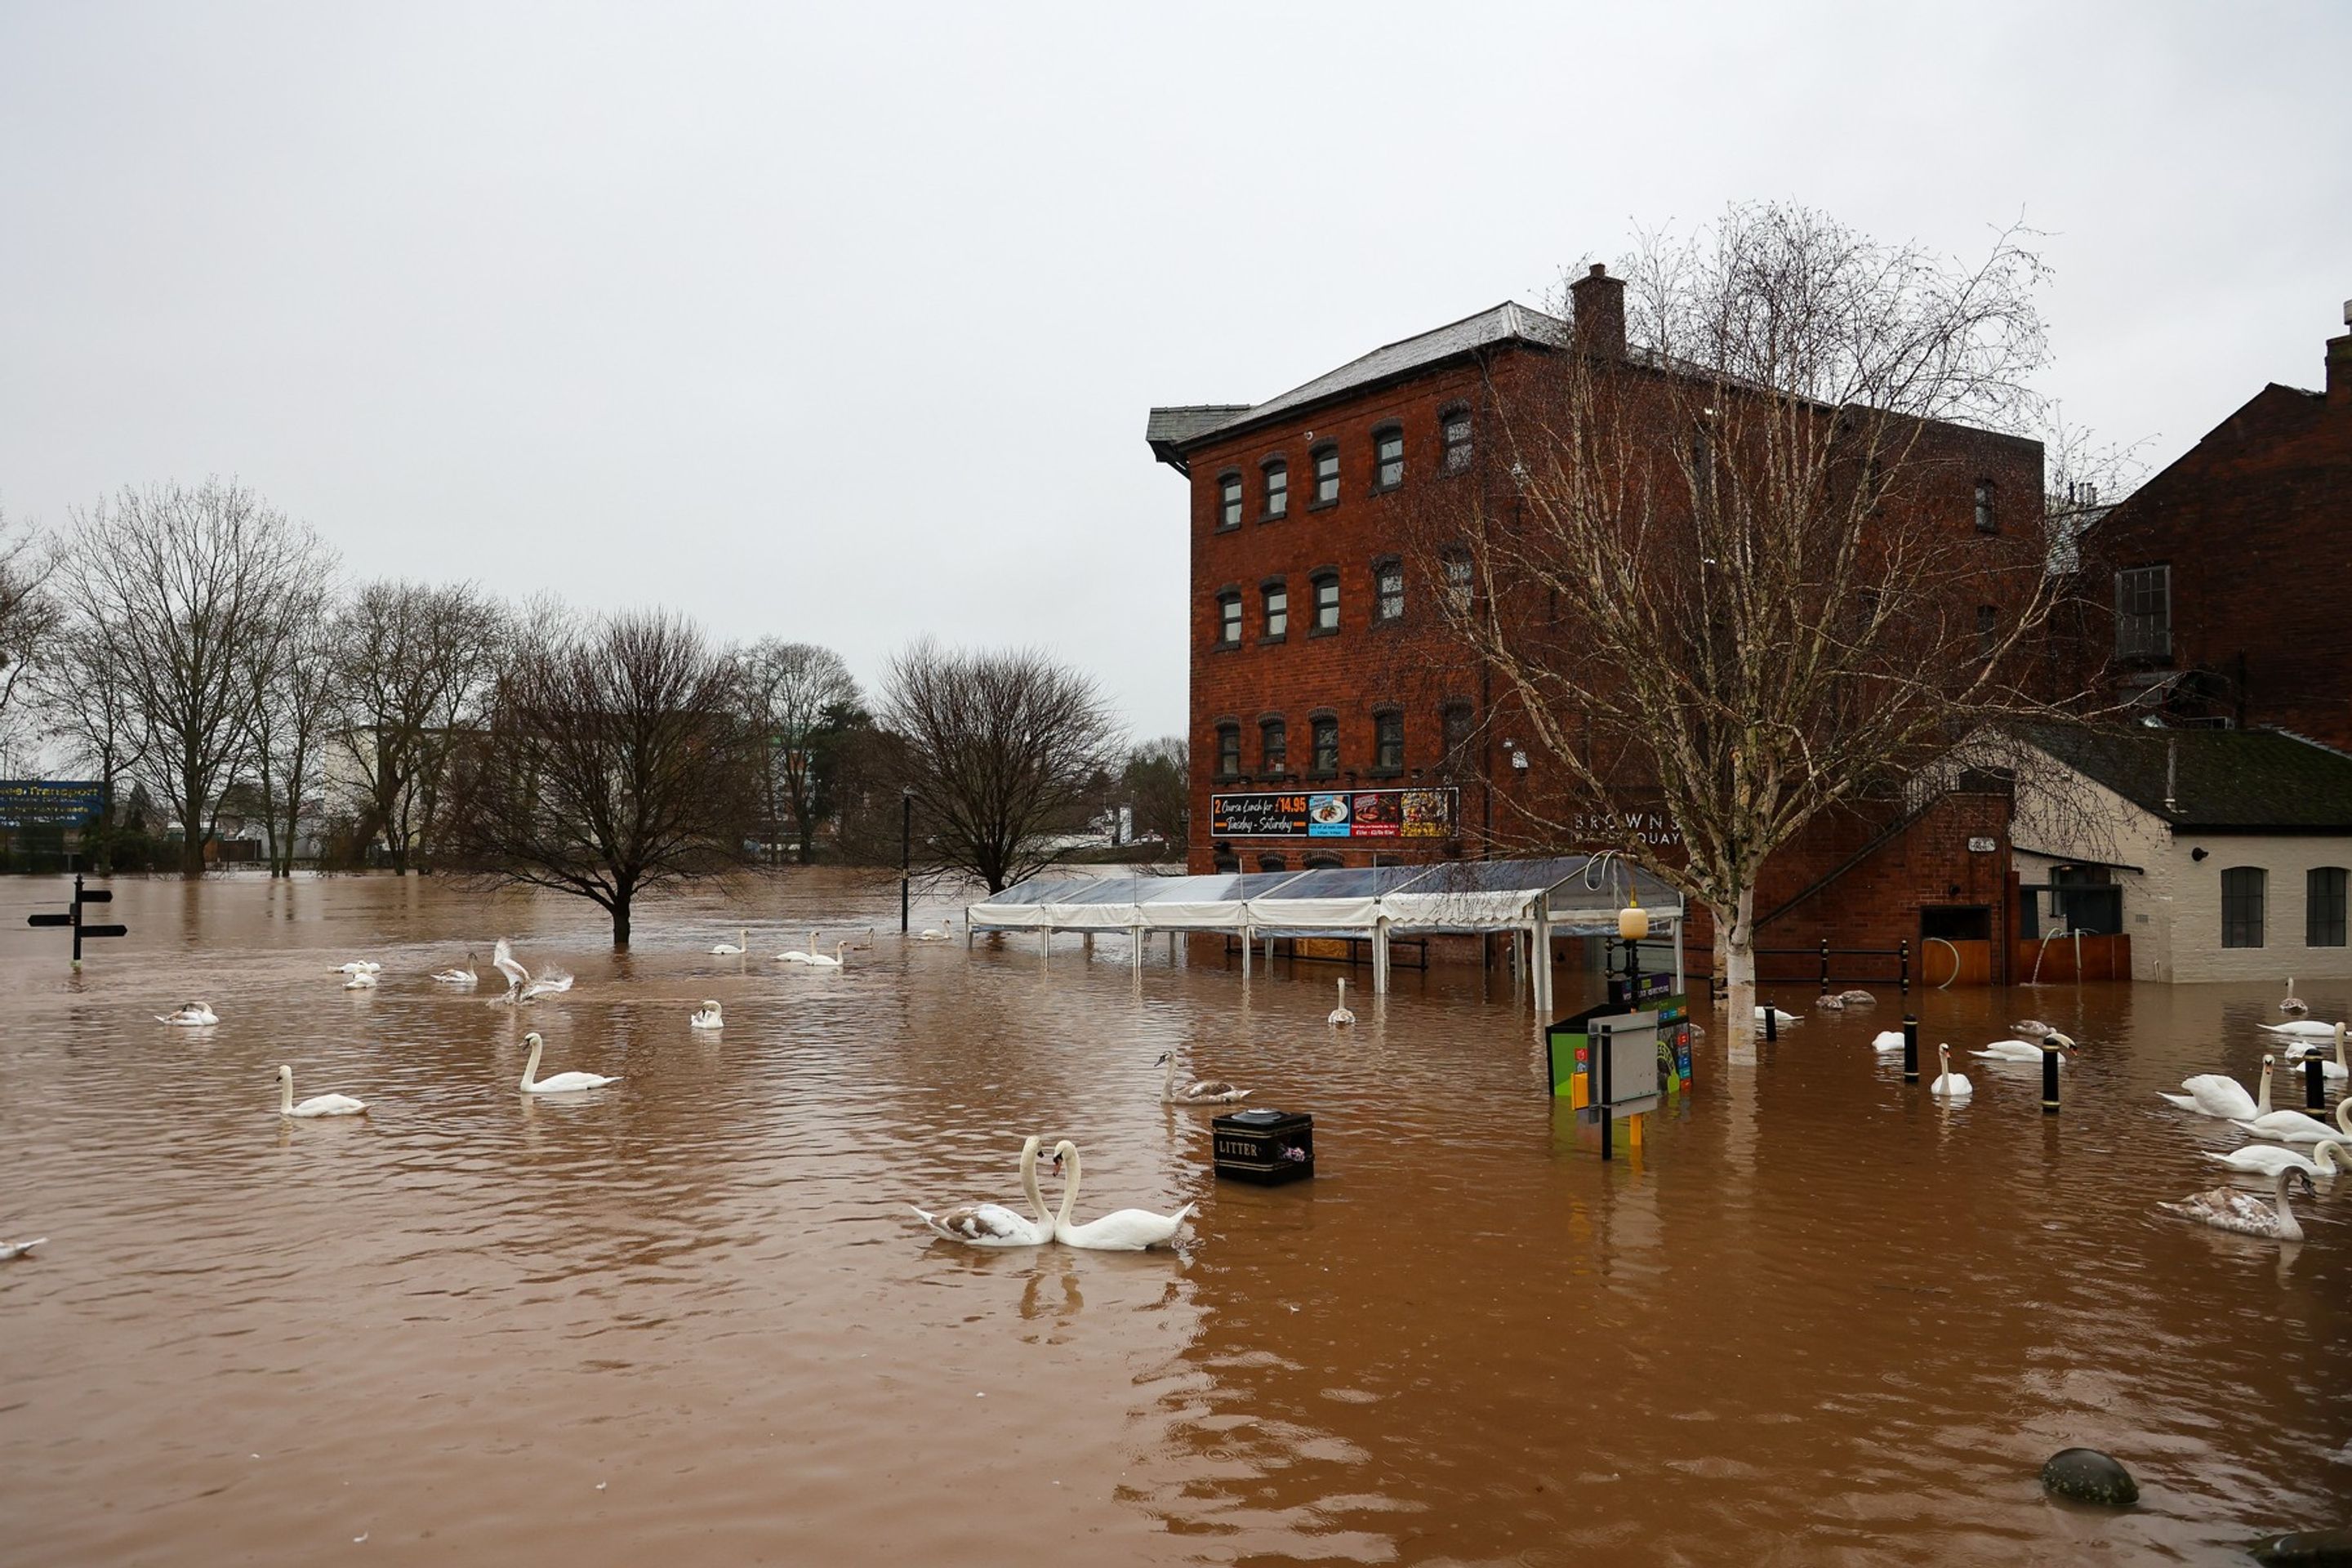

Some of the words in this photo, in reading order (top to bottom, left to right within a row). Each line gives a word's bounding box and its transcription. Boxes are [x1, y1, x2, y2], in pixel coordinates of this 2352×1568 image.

[1214, 799, 1221, 813] 2
[1222, 800, 1241, 813] Course
[1243, 800, 1263, 813] Lunch
[1262, 800, 1273, 814] for
[1274, 796, 1306, 813] £14.95
[1226, 816, 1253, 833] Tuesday
[1259, 816, 1292, 833] Saturday
[1575, 813, 1680, 830] BROWNS
[1636, 832, 1680, 845] QUAY
[1219, 1141, 1258, 1156] LITTER
